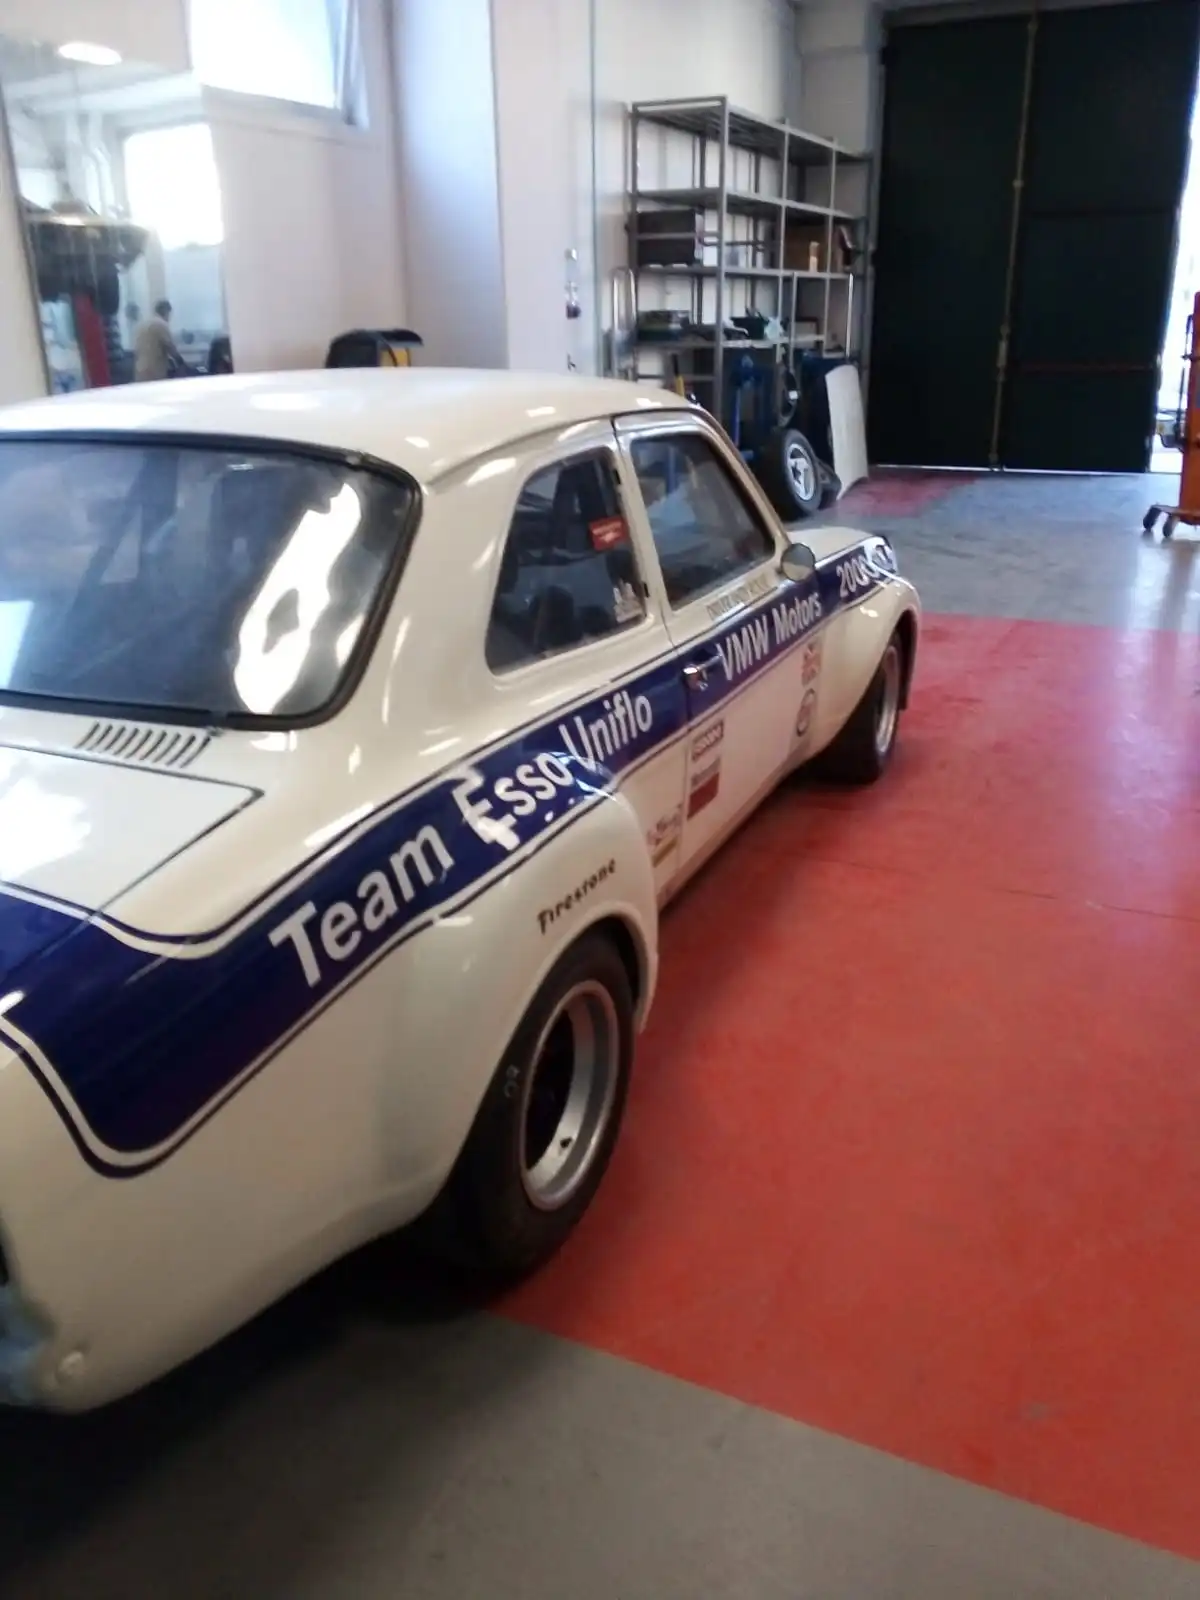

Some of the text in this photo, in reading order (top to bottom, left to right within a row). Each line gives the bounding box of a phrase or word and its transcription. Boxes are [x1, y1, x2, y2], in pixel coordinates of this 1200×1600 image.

[716, 615, 769, 681] VMW
[772, 592, 822, 645] Motors
[268, 824, 455, 988] Team
[451, 752, 573, 852] Esso
[559, 690, 652, 771] Uniflo
[537, 858, 616, 935] Firestone
